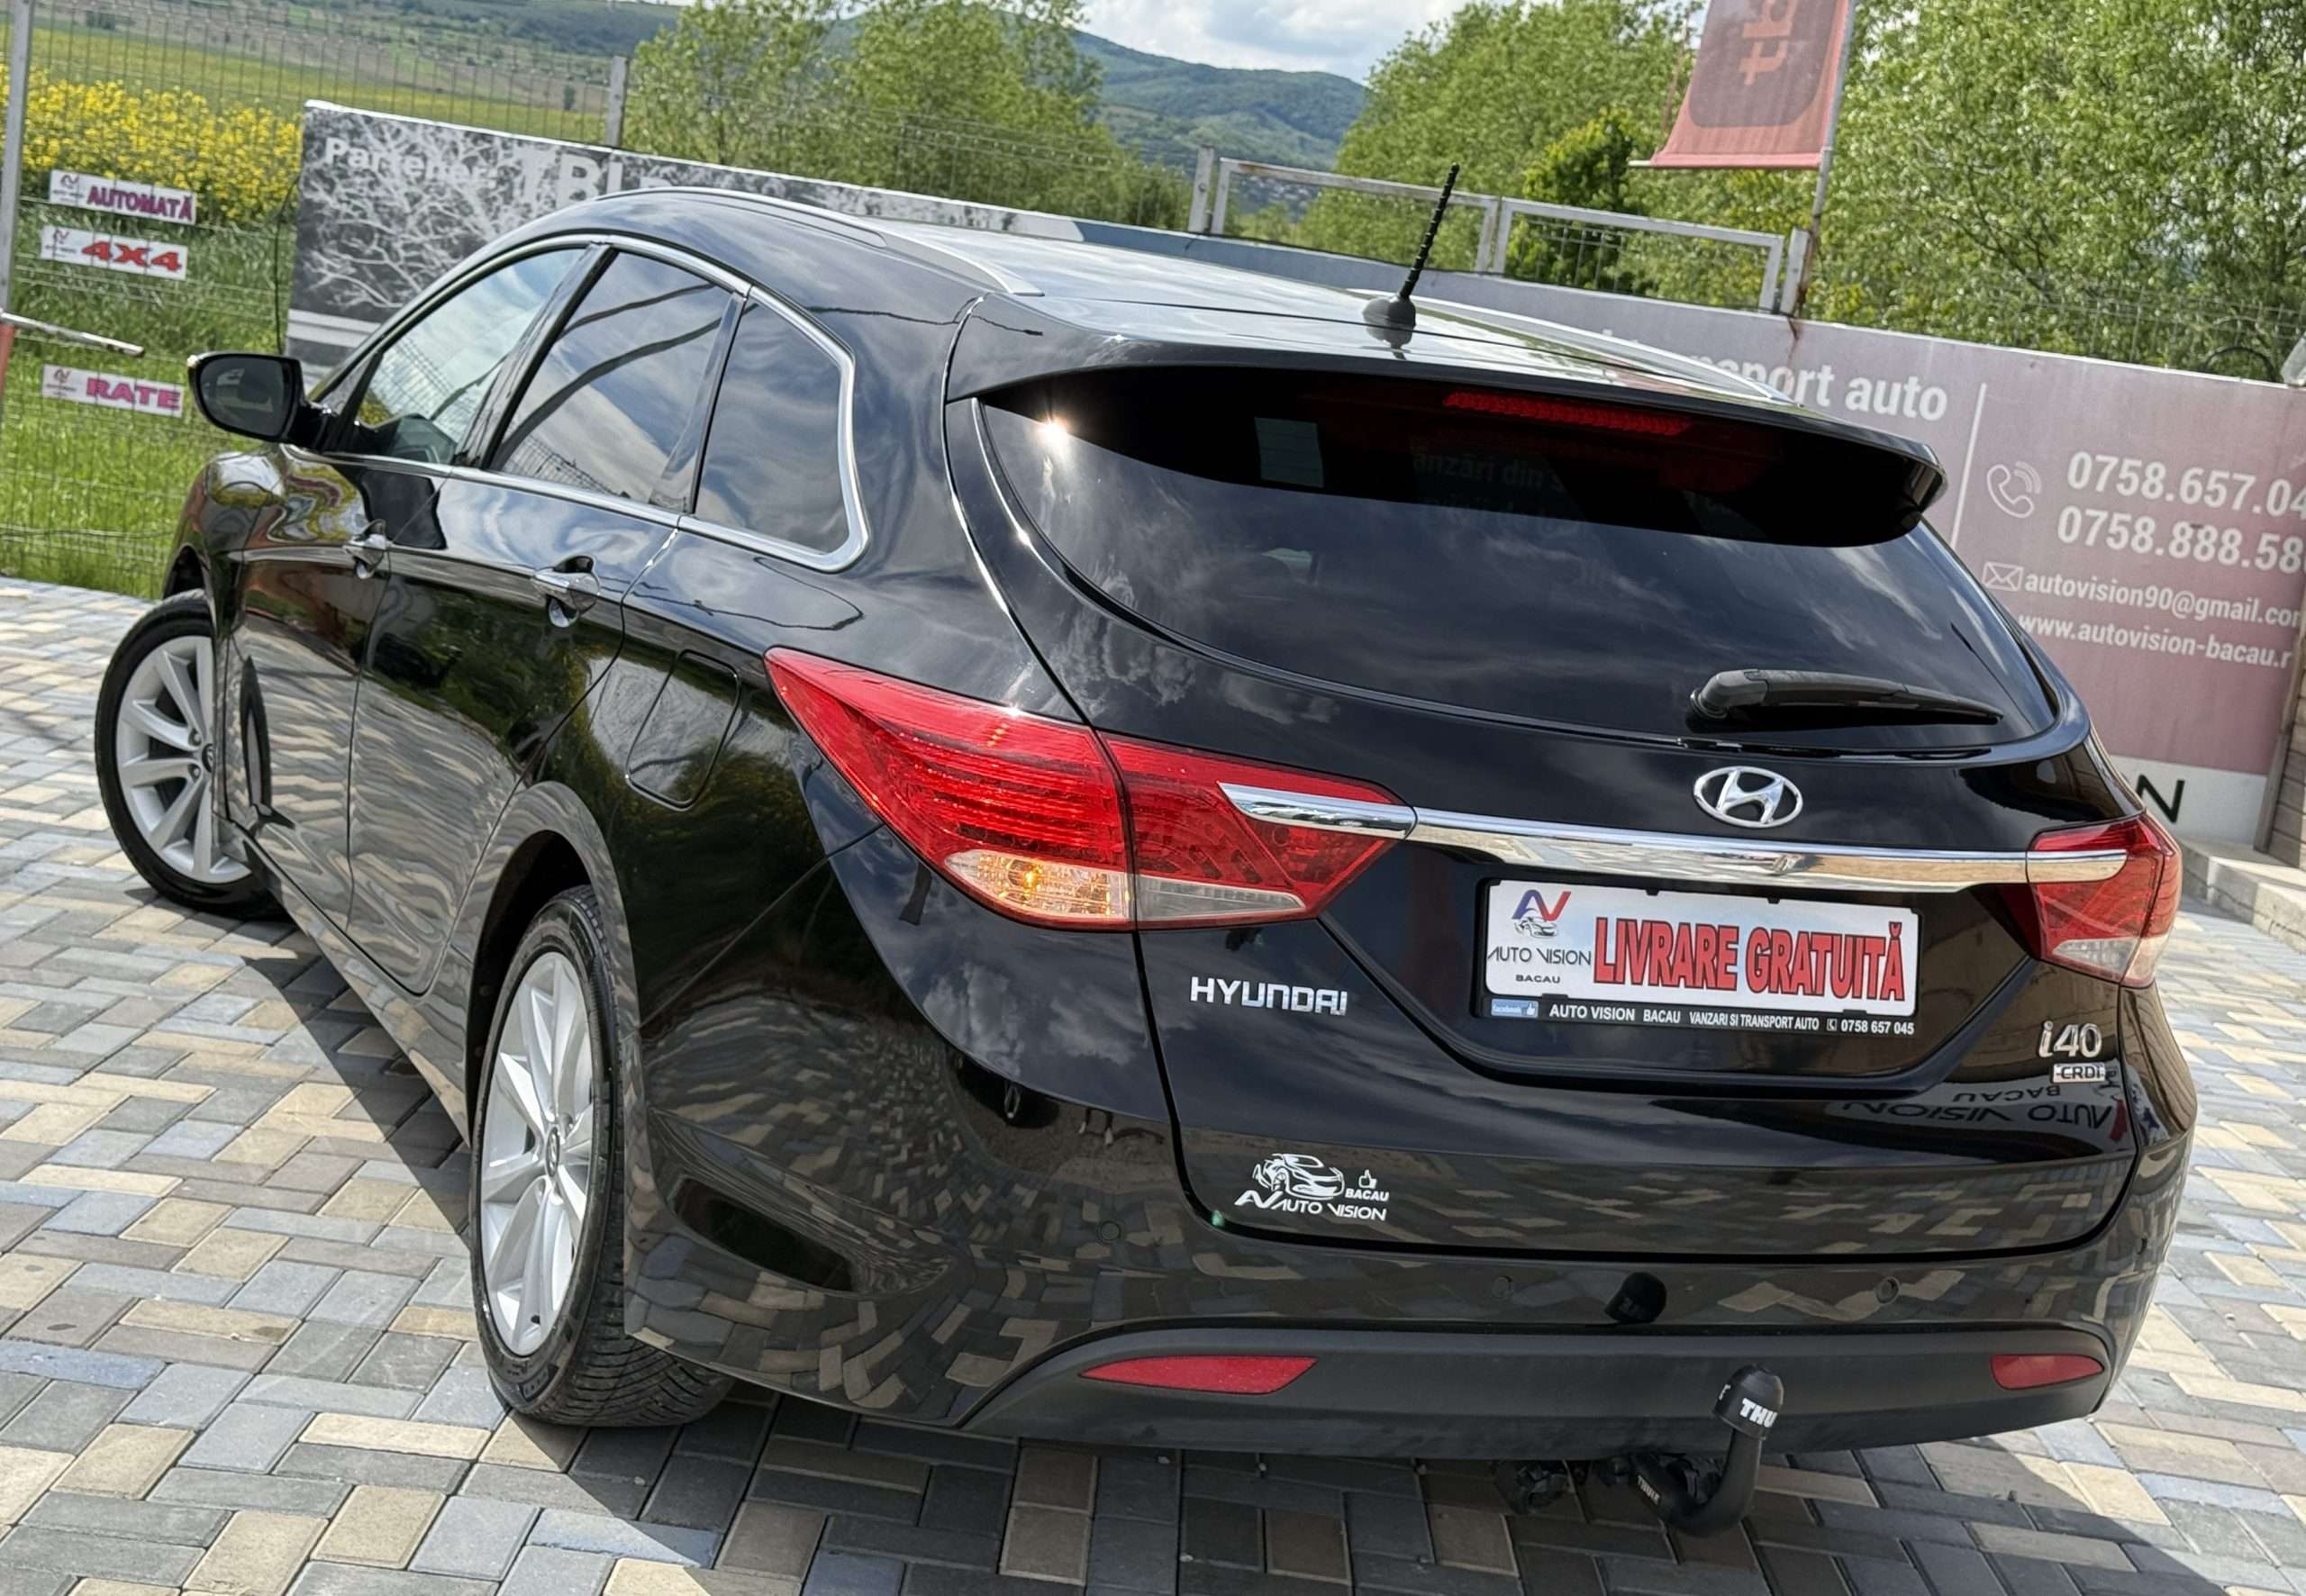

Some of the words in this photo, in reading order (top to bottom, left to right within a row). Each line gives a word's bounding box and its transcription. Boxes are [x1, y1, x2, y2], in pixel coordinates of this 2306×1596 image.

[86, 185, 193, 222] AUTOMATĂ
[86, 376, 181, 411] RATE
[1845, 376, 1948, 421] auto
[2057, 506, 2306, 576] 0758.888.58
[1487, 946, 1532, 963] AUTO
[1536, 948, 1592, 966] VISION
[1593, 916, 1739, 992] LIVRARE
[1745, 921, 1906, 1002] GRATUITĂ
[1189, 976, 1348, 1016] HYUNDAI
[1515, 974, 1561, 984] BACAU
[1549, 1003, 1588, 1019] AUTO
[1591, 1006, 1636, 1021] VISION
[1643, 1009, 1681, 1023] BACAU
[1690, 1011, 1729, 1026] VANZARI
[1730, 1013, 1739, 1027] SI
[1740, 1014, 1794, 1029] TRANSPORT
[1793, 1016, 1820, 1031] AUTO
[1840, 1019, 1869, 1033] 0758
[1871, 1020, 1892, 1034] 657
[1893, 1021, 1915, 1036] 045
[2038, 1020, 2102, 1058] i40
[2028, 1104, 2112, 1129] AUTO
[1271, 1198, 1323, 1215] AUTO
[1326, 1202, 1387, 1221] VISION
[1345, 1187, 1390, 1202] BACAU
